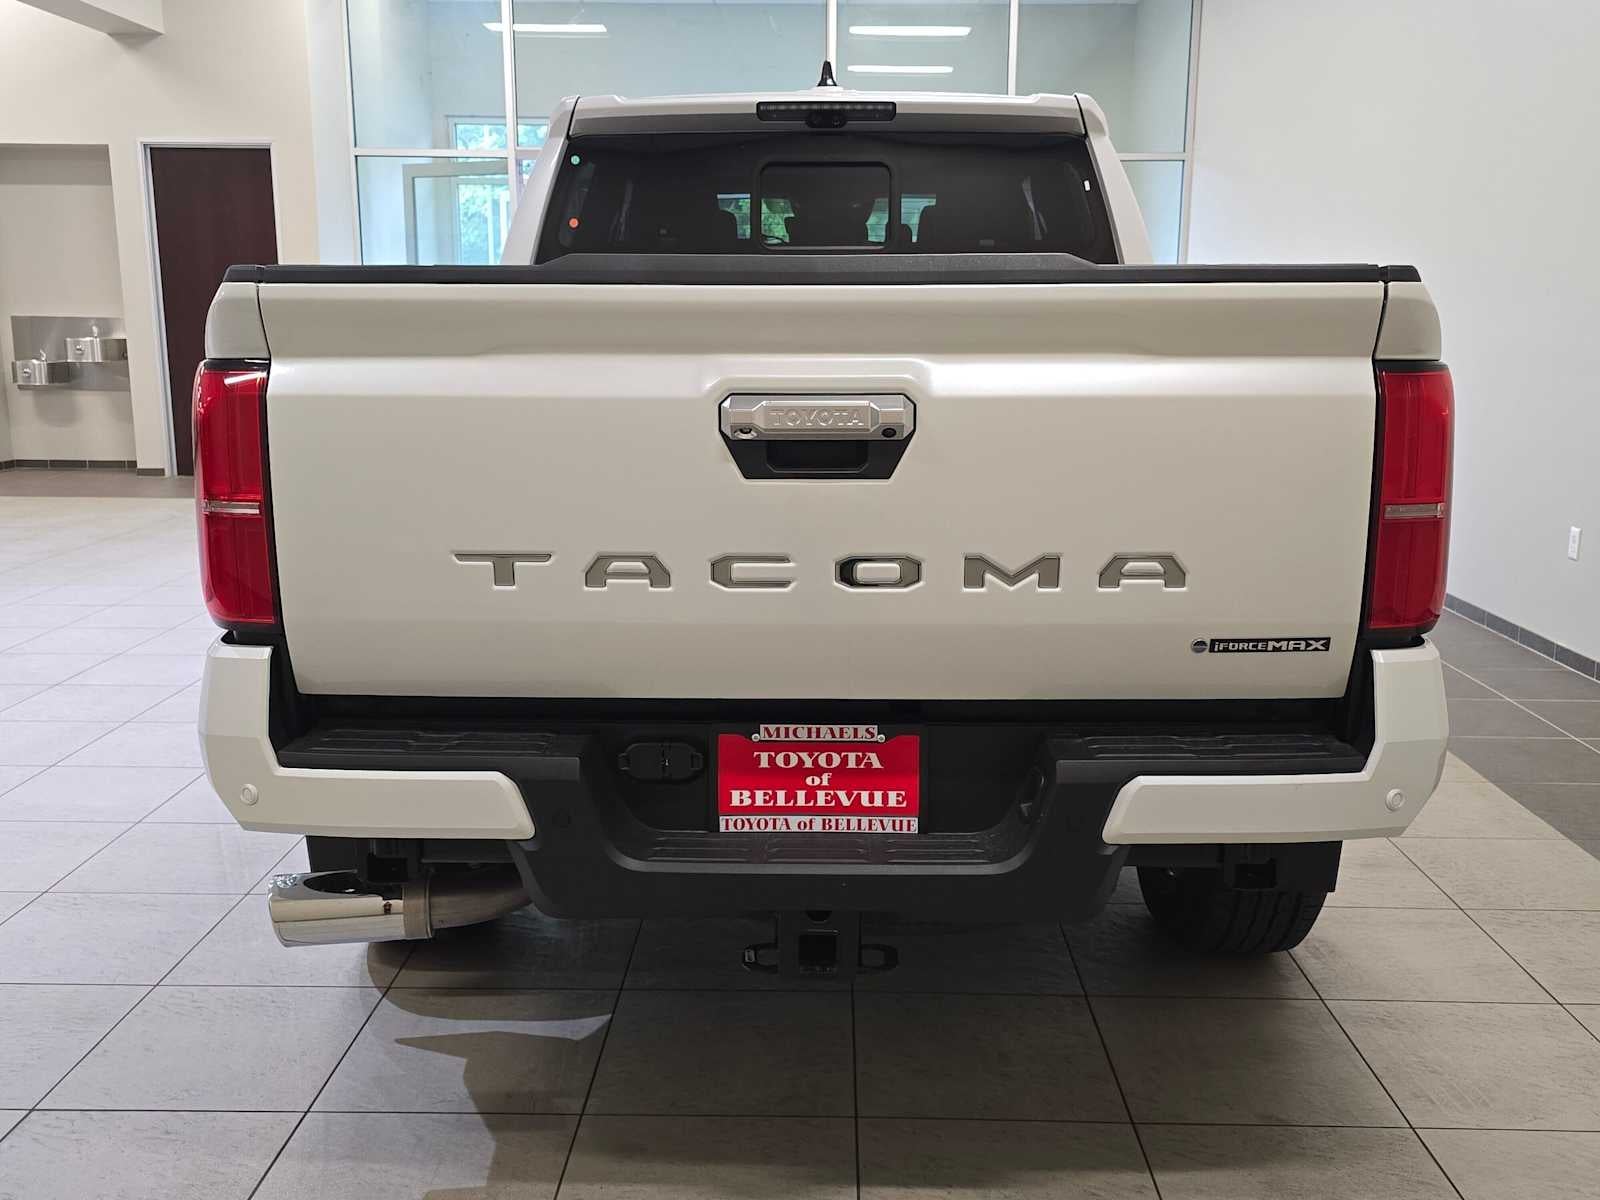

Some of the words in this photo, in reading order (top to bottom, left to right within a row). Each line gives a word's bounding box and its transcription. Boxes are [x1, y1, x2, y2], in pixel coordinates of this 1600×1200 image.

[768, 408, 865, 426] TOYOTA
[452, 551, 1190, 592] TACOMA
[762, 726, 877, 740] MICHAELS
[753, 751, 884, 769] TOYOTA
[805, 772, 833, 786] of
[729, 789, 907, 808] BELLEVUE
[720, 817, 791, 831] TOYOTA
[796, 817, 816, 831] of
[821, 817, 918, 832] BELLEVUE
